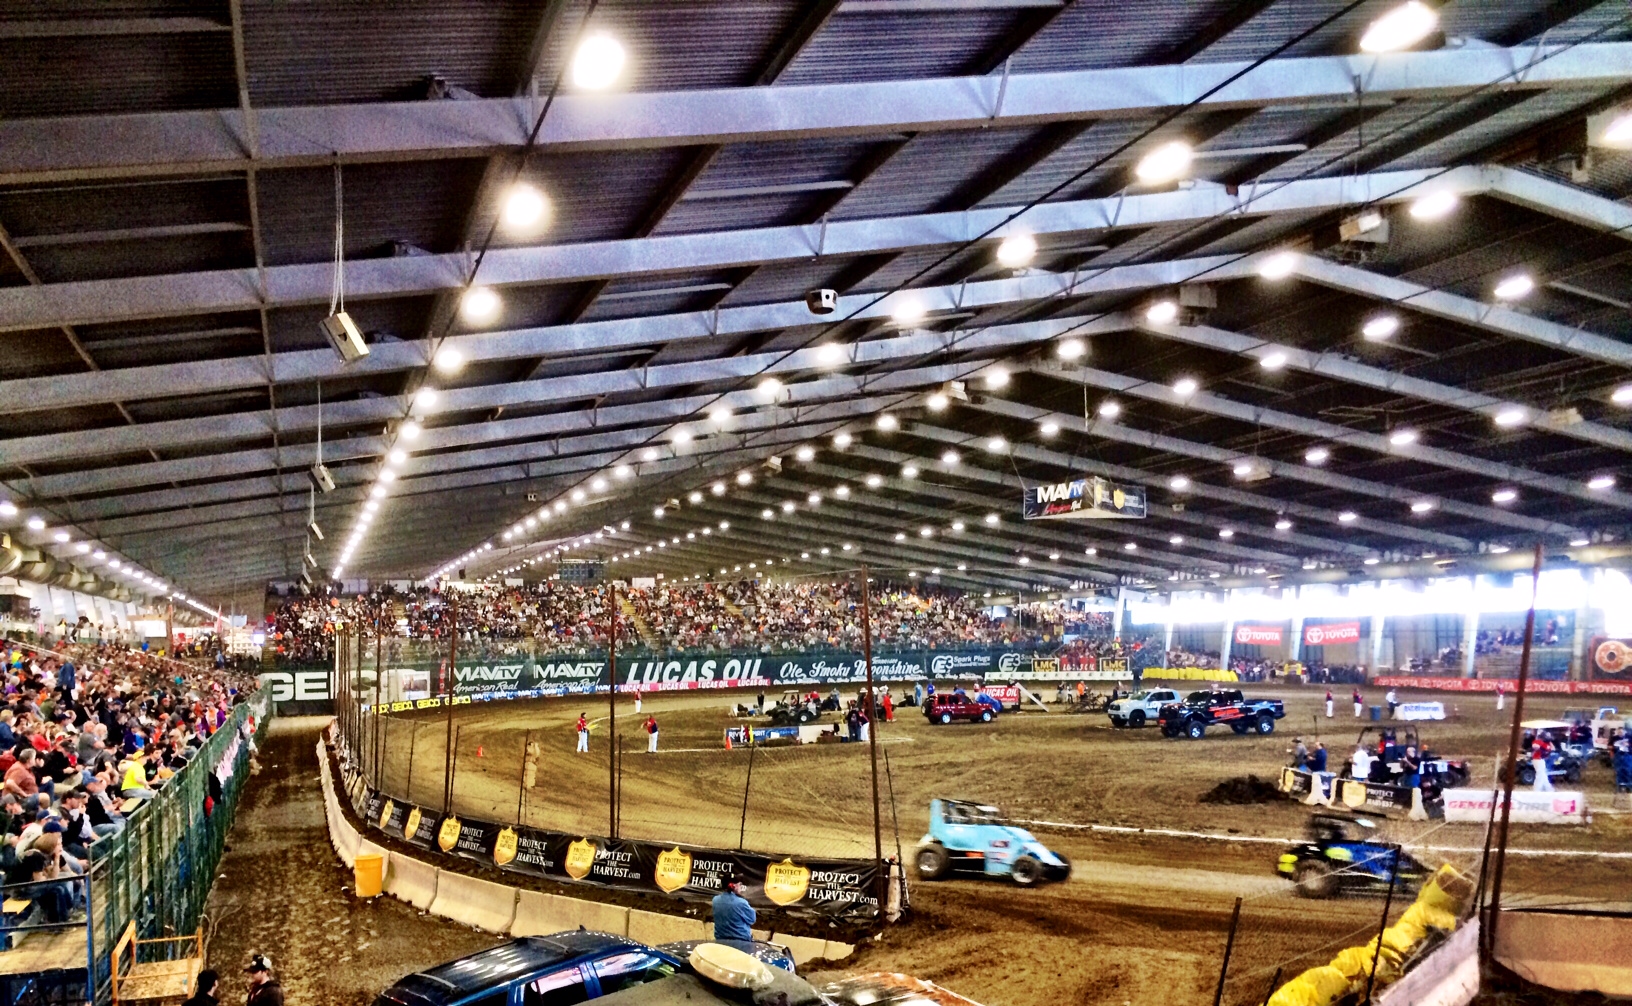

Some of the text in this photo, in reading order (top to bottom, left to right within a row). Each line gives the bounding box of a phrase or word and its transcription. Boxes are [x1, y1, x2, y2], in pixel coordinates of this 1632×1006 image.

[1037, 481, 1085, 503] MAVTV
[1252, 631, 1280, 640] TOYOTA
[1325, 628, 1358, 639] TOYOTA
[973, 656, 990, 664] Plugs
[1034, 661, 1056, 669] LMC
[1103, 660, 1126, 669] LMC
[449, 665, 523, 681] MAVTV
[534, 663, 605, 678] MAVTV
[626, 659, 763, 684] LUCAS OIL
[780, 662, 804, 678] Ole
[809, 661, 850, 677] Smoky
[495, 681, 519, 693] Real
[640, 683, 651, 691] OIL
[659, 682, 689, 690] LUCAS OIL
[698, 680, 728, 689] LUCAS OIL
[737, 679, 757, 687] LUCAS
[758, 679, 769, 687] OIL
[1432, 680, 1463, 688] TOYOTA
[1533, 682, 1570, 691] TOYOTA
[983, 688, 1017, 697] LUCAS OIL
[1592, 684, 1631, 693] TOYOTA
[417, 698, 440, 708] GEICO
[1367, 788, 1394, 798] PROTECT
[461, 826, 484, 838] PROTECT
[519, 837, 548, 851] PROTECT
[595, 849, 632, 862] PROTECT
[693, 859, 734, 873] PROTECT
[593, 864, 641, 880] HARVEST.com
[775, 868, 802, 876] PROTECT
[811, 870, 859, 884] PROTECT
[827, 882, 842, 890] THE
[809, 887, 878, 905] HARVEST.com
